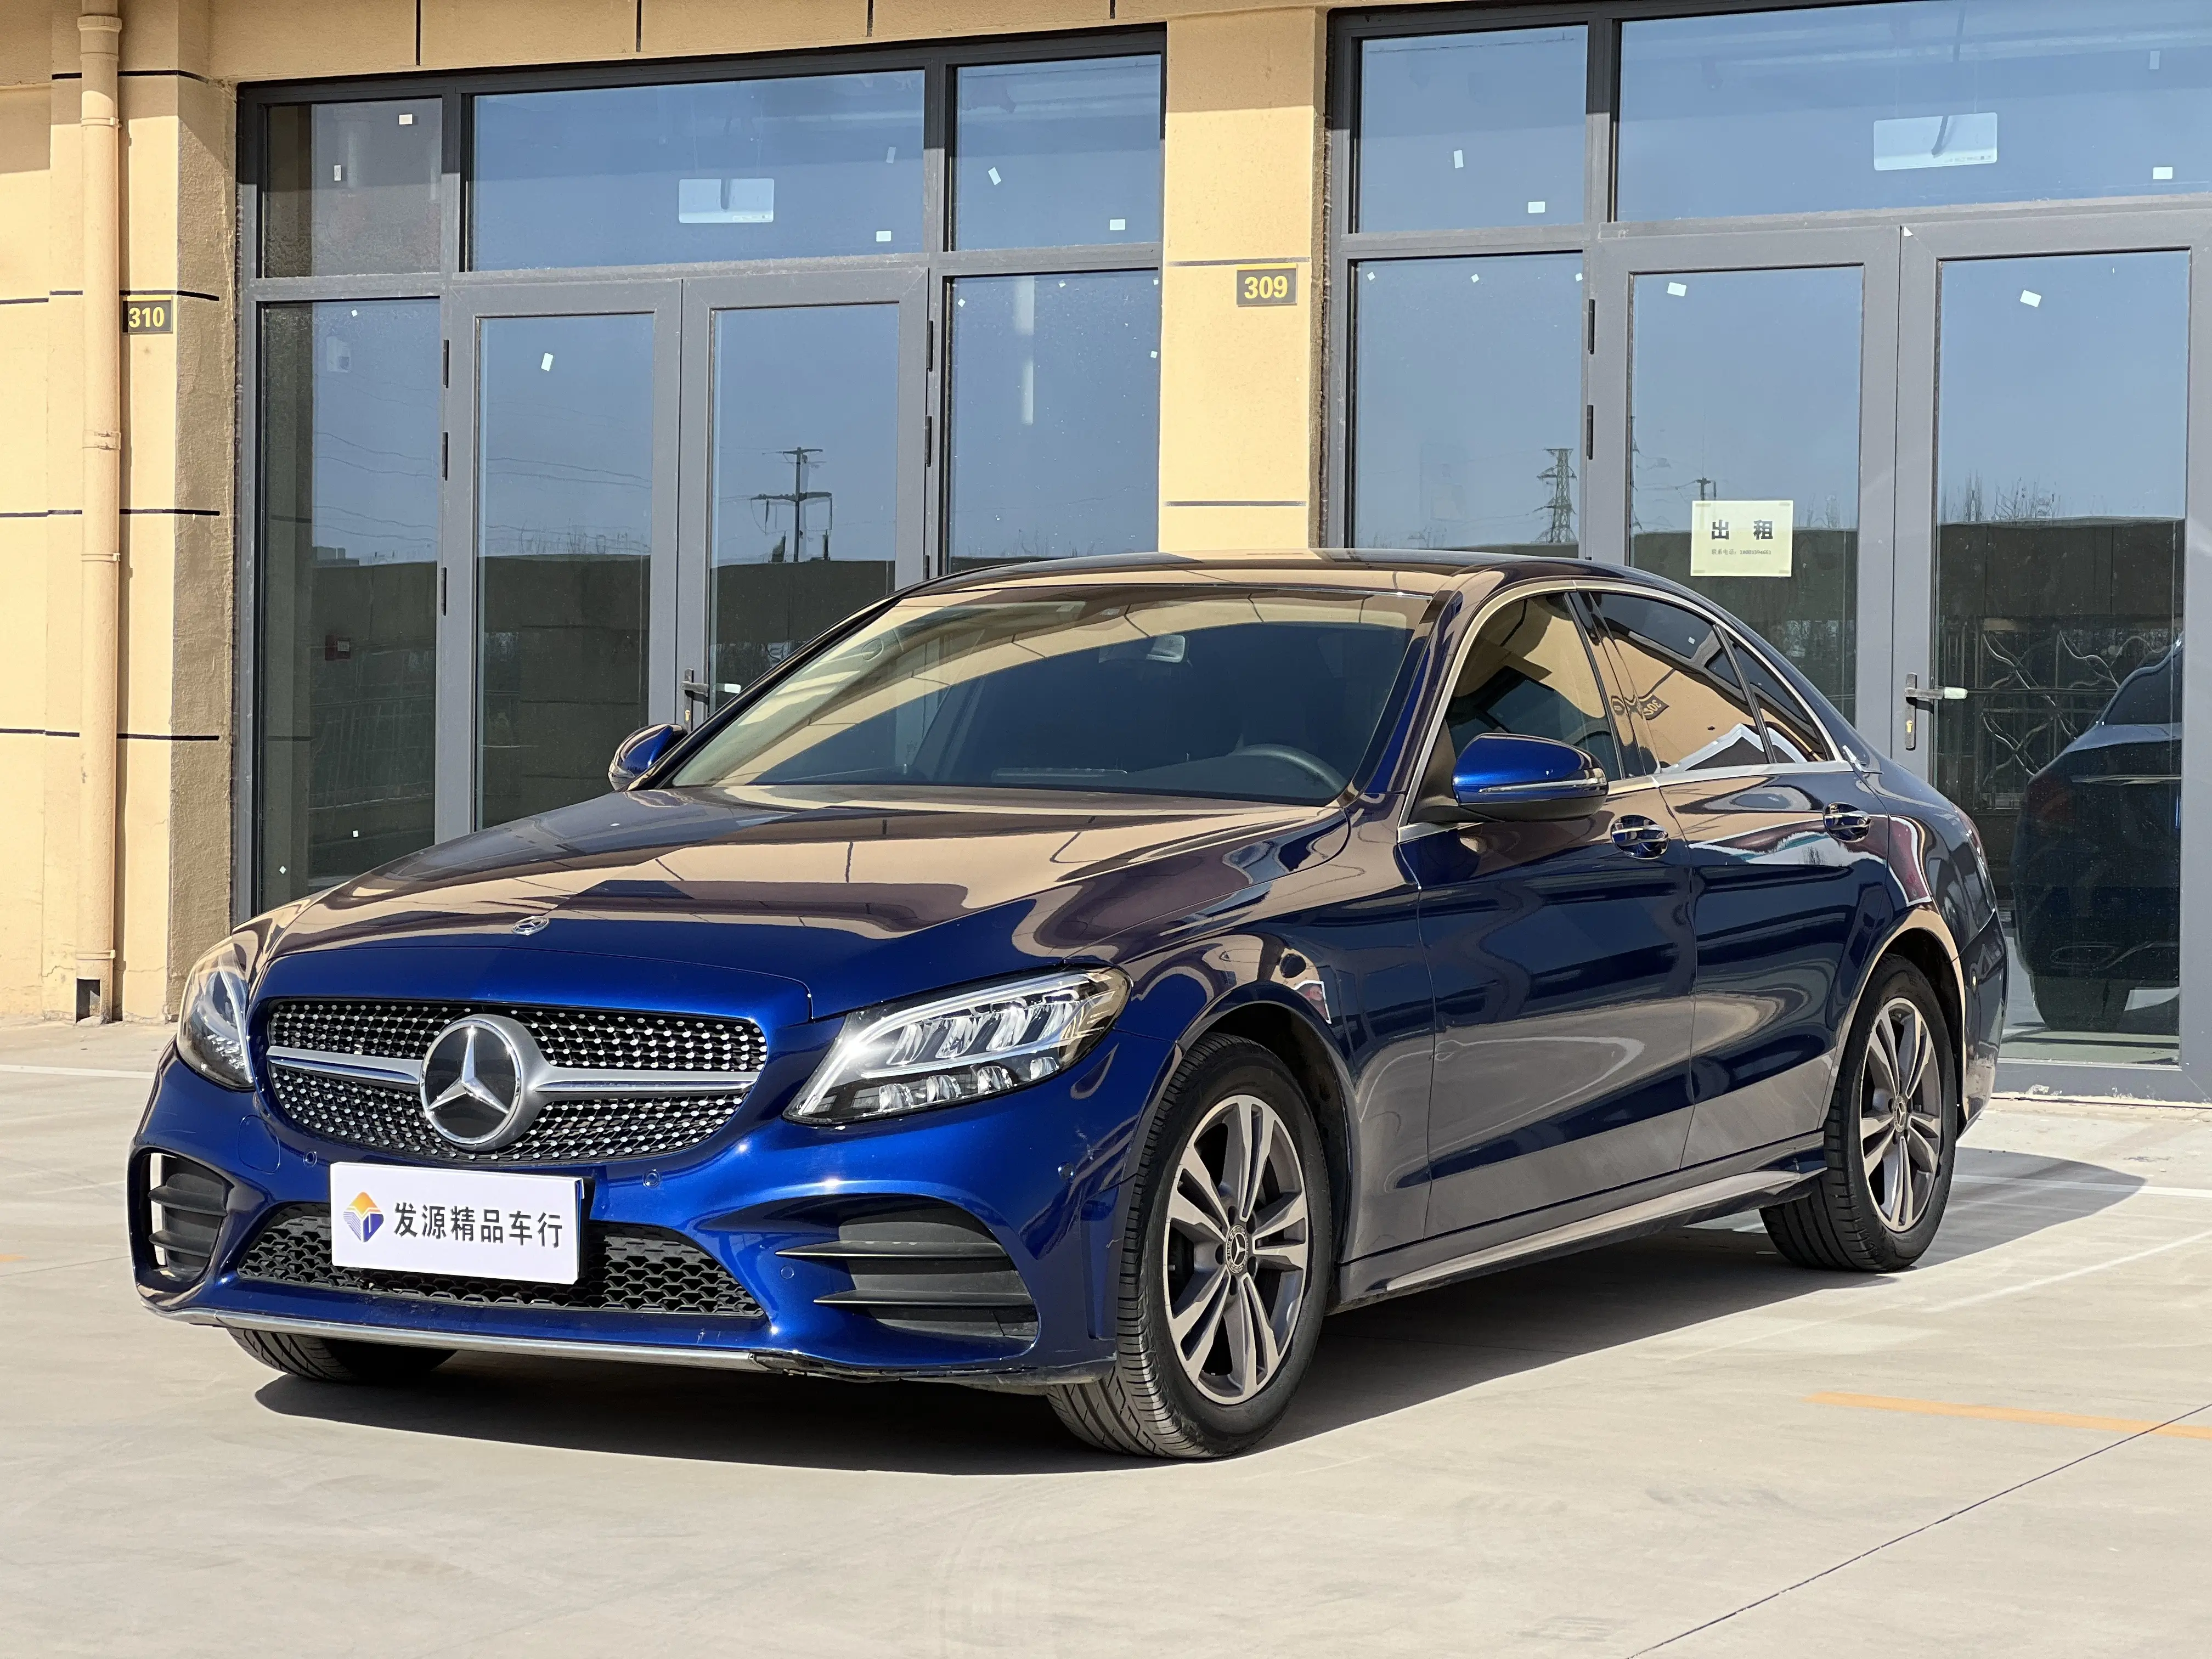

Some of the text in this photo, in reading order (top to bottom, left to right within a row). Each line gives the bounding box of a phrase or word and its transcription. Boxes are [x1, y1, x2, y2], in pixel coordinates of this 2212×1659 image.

[1244, 275, 1288, 299] 309
[128, 306, 165, 328] 310
[394, 1202, 563, 1248] 发源精品车行
